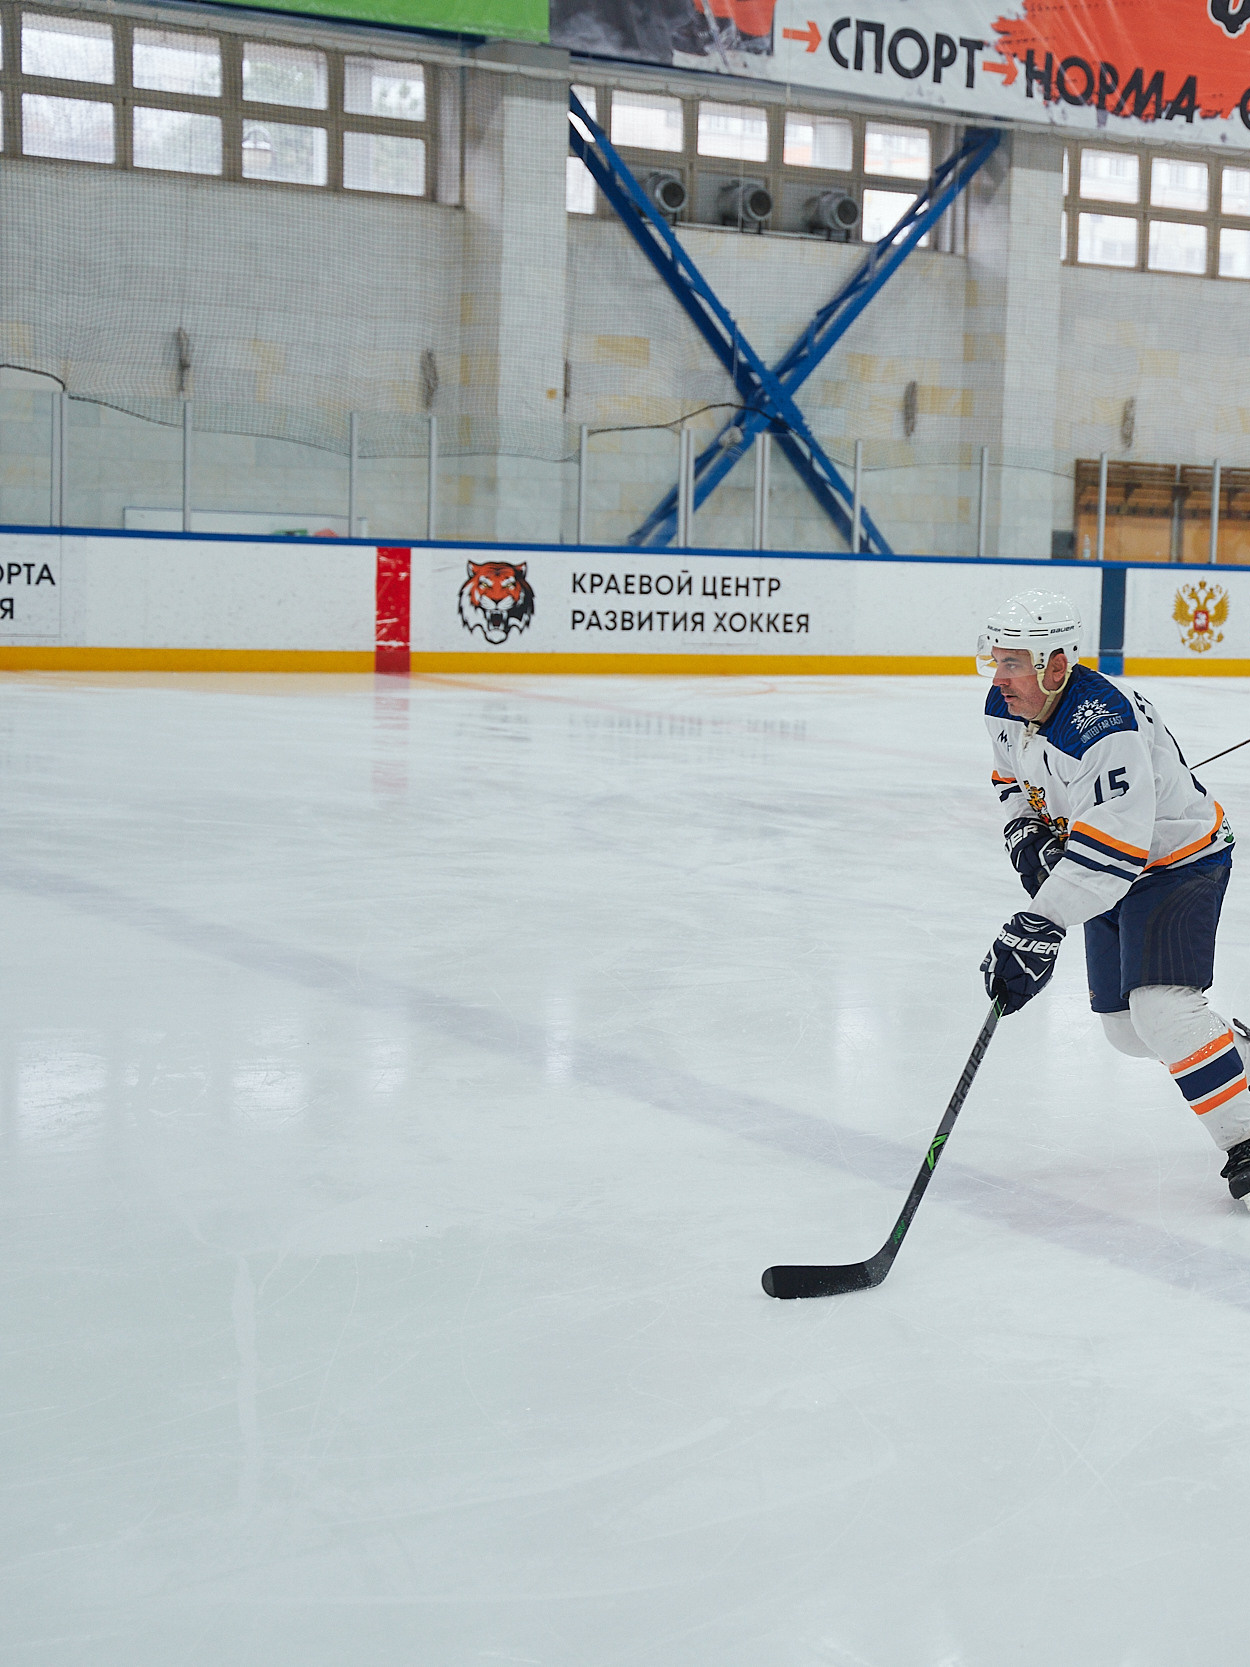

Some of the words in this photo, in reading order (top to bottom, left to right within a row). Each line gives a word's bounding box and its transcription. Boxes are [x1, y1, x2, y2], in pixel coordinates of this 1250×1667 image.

[828, 17, 984, 88] СПОРТ
[1025, 49, 1197, 123] НОРМА
[572, 570, 693, 596] КРАЕВОЙ
[702, 576, 782, 600] ЦЕНТР
[571, 610, 705, 632] РАЗВИТИЯ
[714, 612, 810, 633] ХОККЕЯ
[1081, 725, 1100, 743] UNITED
[1098, 719, 1110, 731] FAR
[1109, 715, 1123, 726] EAST
[1094, 766, 1130, 807] 15
[998, 929, 1061, 955] BAUER
